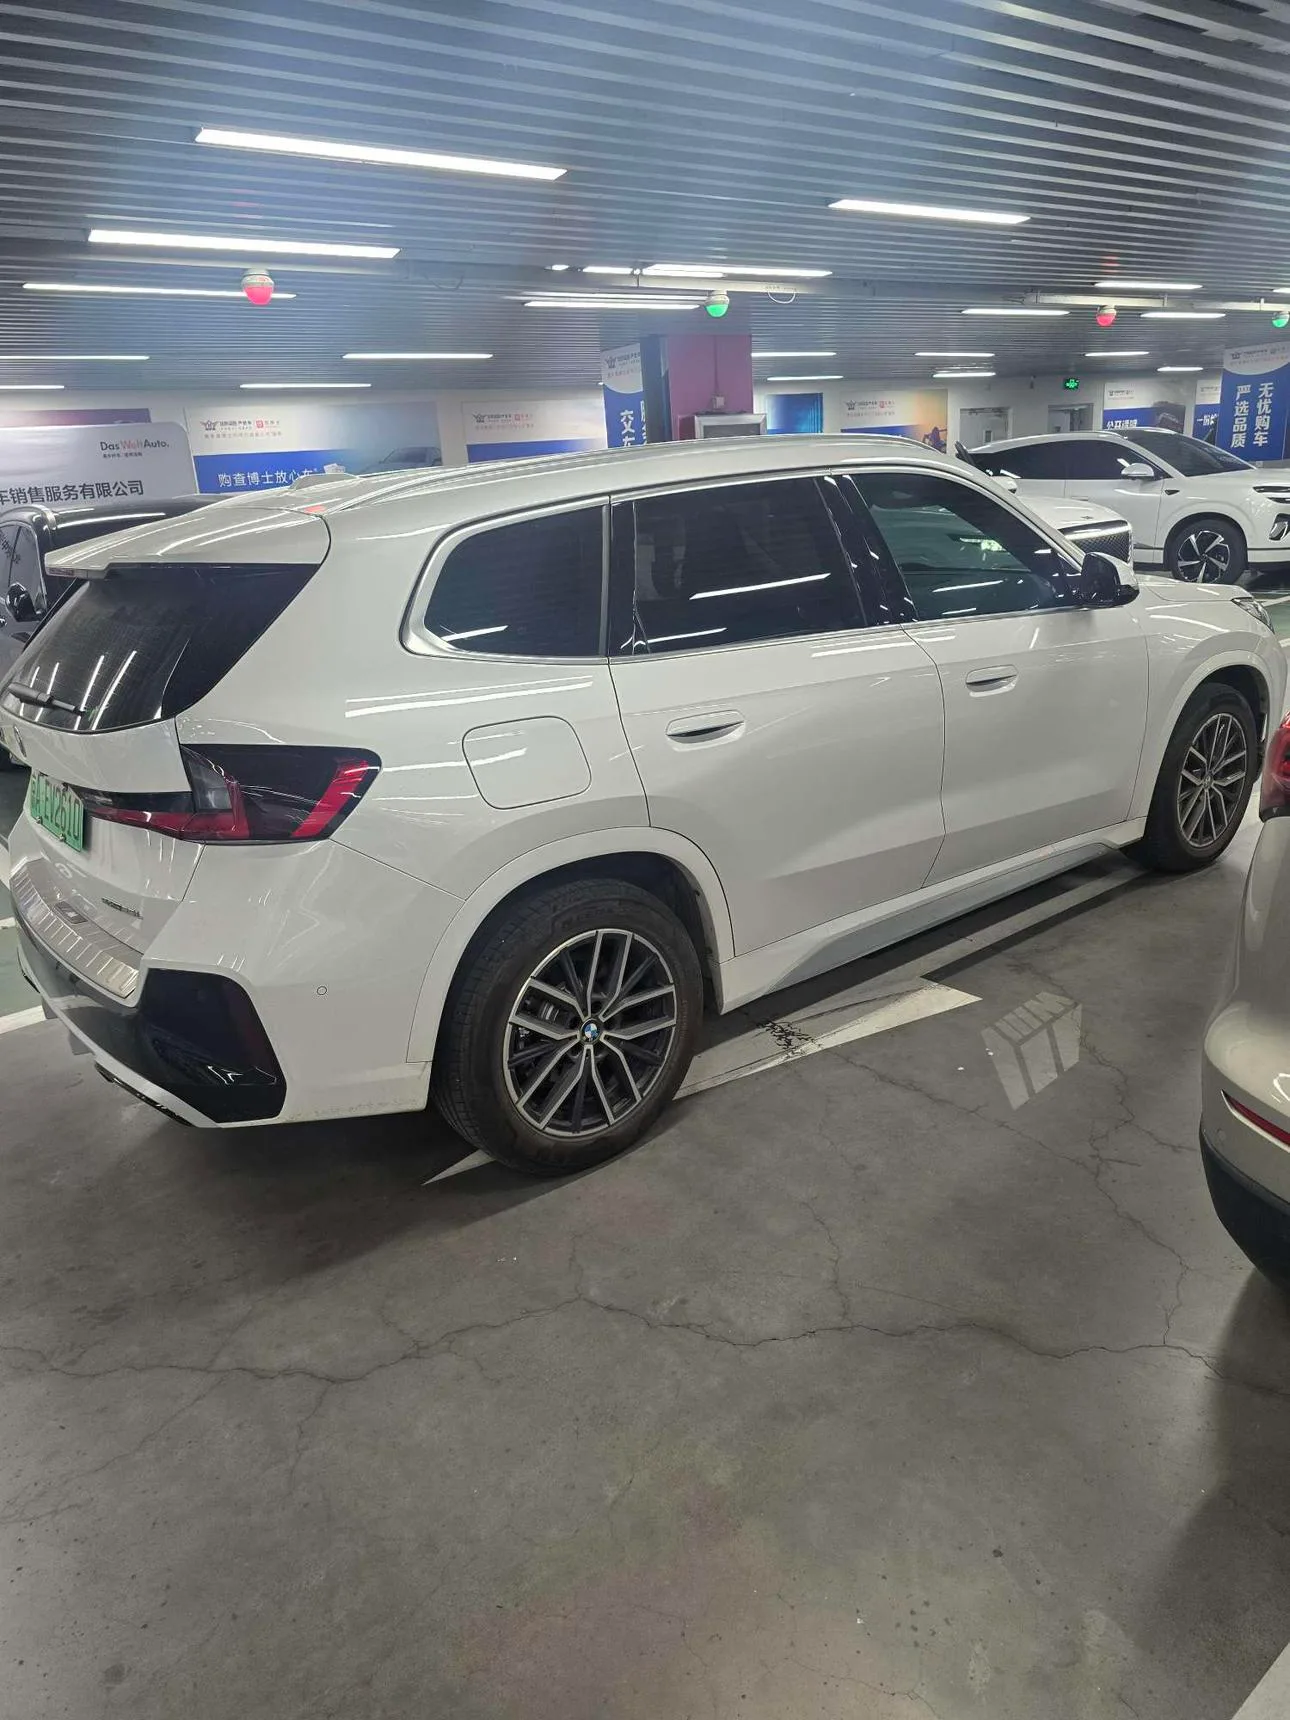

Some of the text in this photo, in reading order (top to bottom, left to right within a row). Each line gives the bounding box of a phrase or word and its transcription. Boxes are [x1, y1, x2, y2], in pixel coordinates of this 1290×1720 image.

[1230, 384, 1252, 449] 严选品质
[1253, 382, 1275, 447] 无忧购车
[100, 441, 120, 451] Das
[217, 468, 317, 488] 购查博士放心
